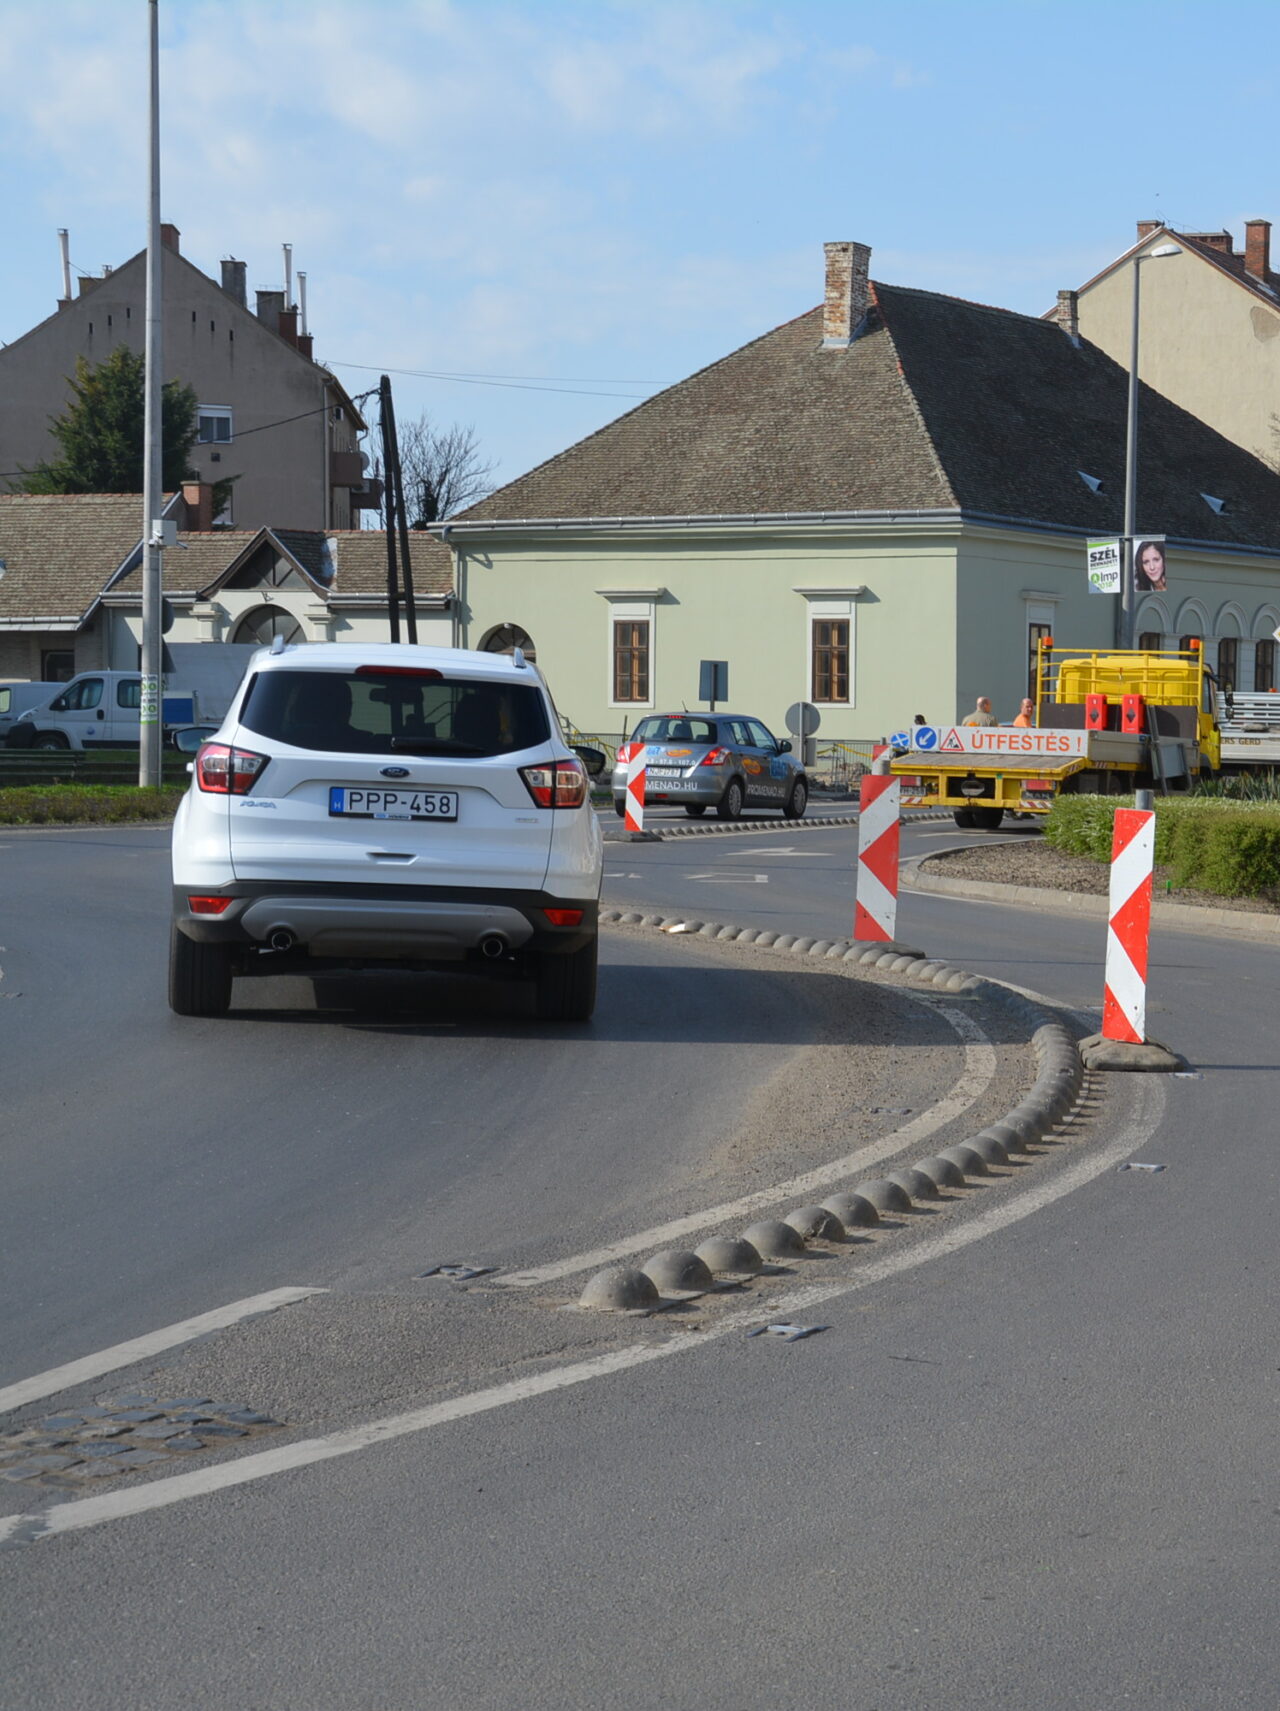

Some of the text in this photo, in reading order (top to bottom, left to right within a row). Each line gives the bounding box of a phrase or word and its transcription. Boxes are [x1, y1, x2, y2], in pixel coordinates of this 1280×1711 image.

[1090, 547, 1117, 562] SZÉL
[971, 730, 1082, 752] ÚTFESTÉS !
[348, 791, 452, 814] PPP-458
